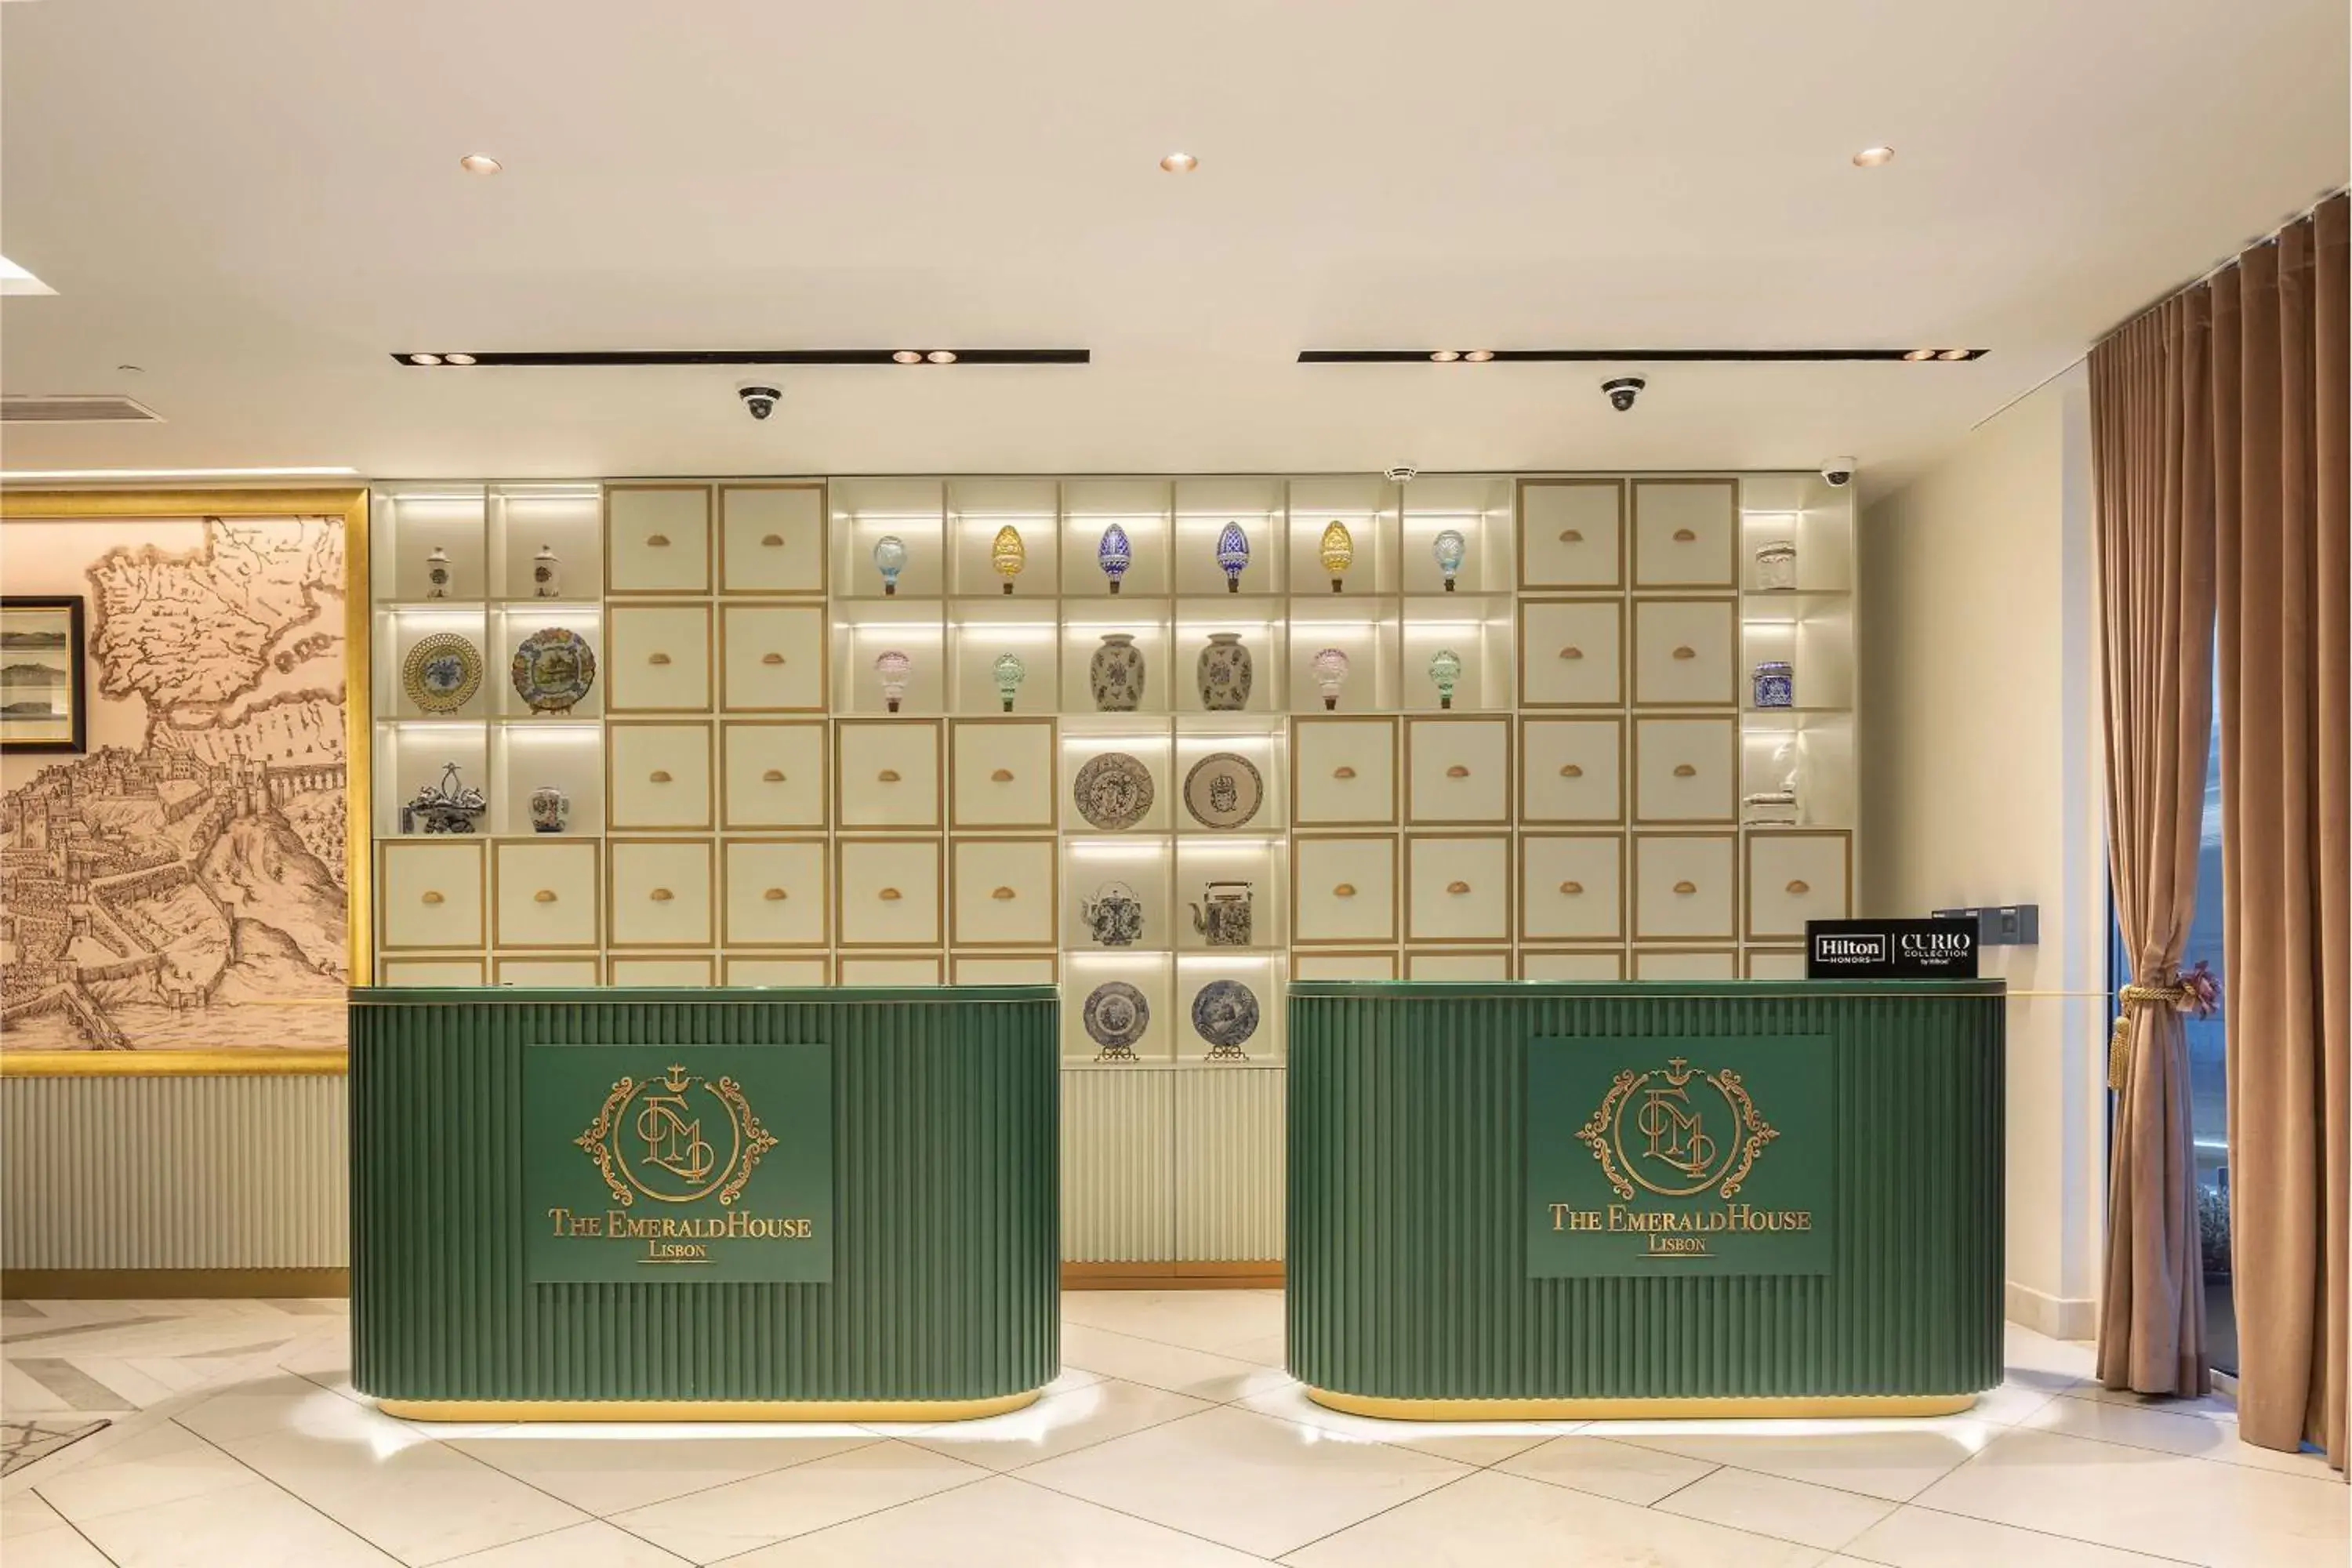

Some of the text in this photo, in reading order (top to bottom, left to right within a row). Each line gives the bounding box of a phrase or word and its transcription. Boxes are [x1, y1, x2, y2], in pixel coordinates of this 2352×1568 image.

[1821, 940, 1879, 955] Hilton
[1901, 934, 1970, 949] CURIO
[648, 1240, 707, 1258] LISBON
[1649, 1233, 1707, 1251] LISBON
